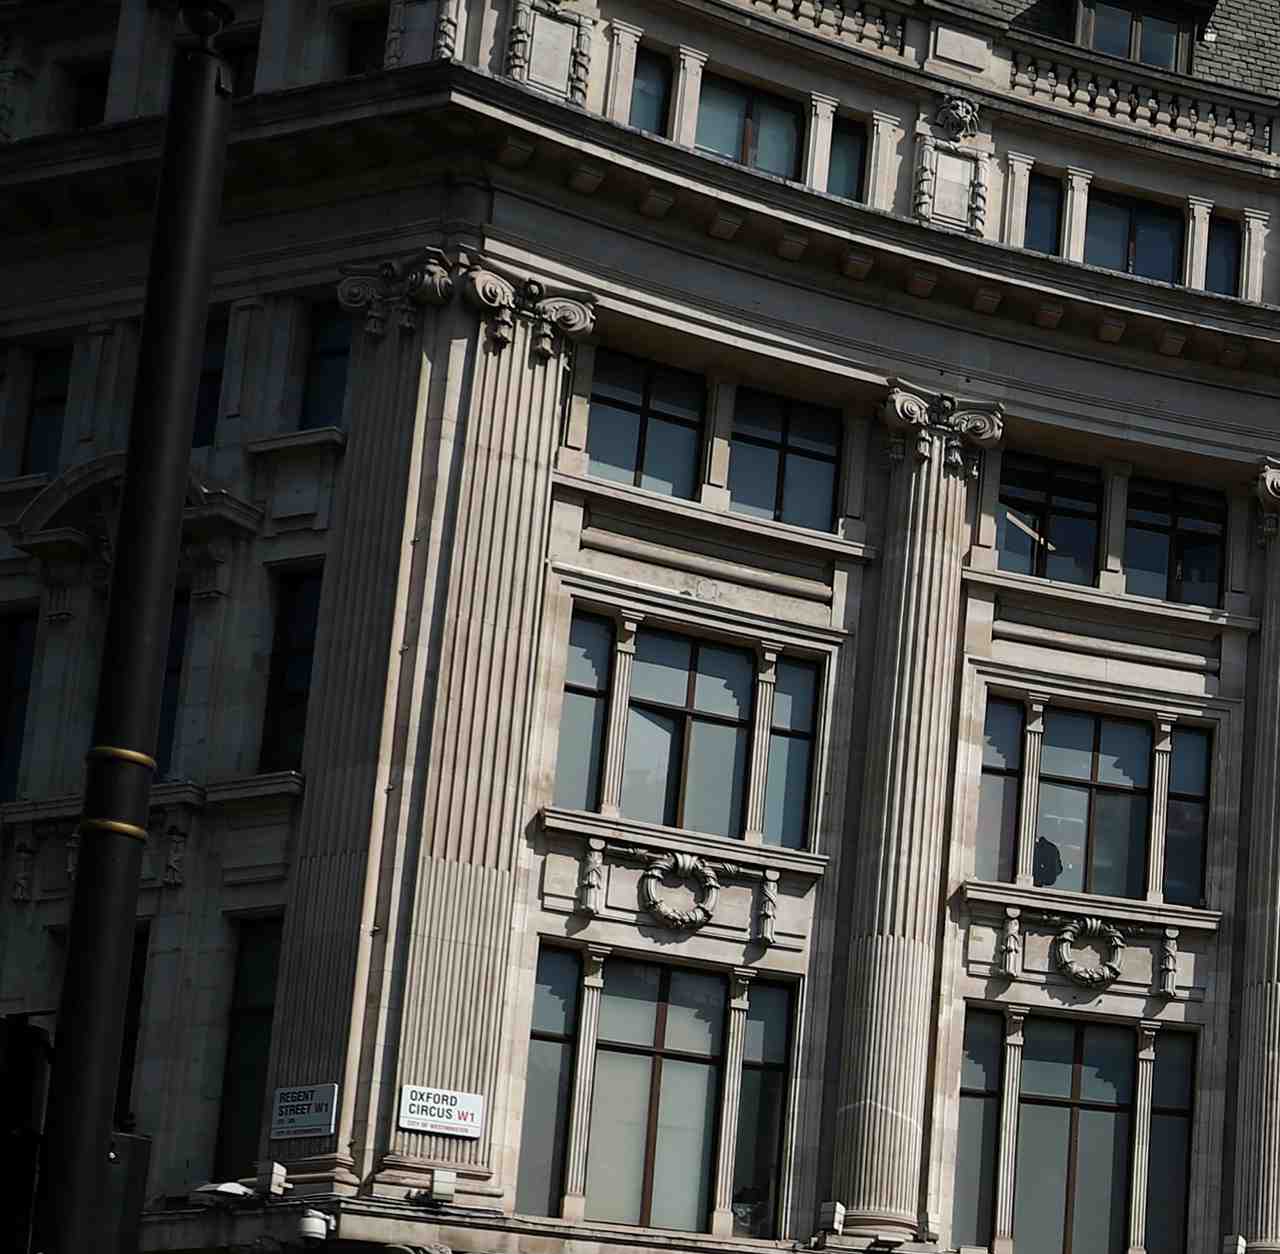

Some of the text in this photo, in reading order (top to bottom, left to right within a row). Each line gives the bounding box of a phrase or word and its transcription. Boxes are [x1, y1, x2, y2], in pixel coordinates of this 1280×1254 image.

[279, 1090, 315, 1103] REGENT
[410, 1089, 458, 1107] OXFORD
[278, 1103, 312, 1117] STREET
[408, 1103, 475, 1122] CIRCUS W1
